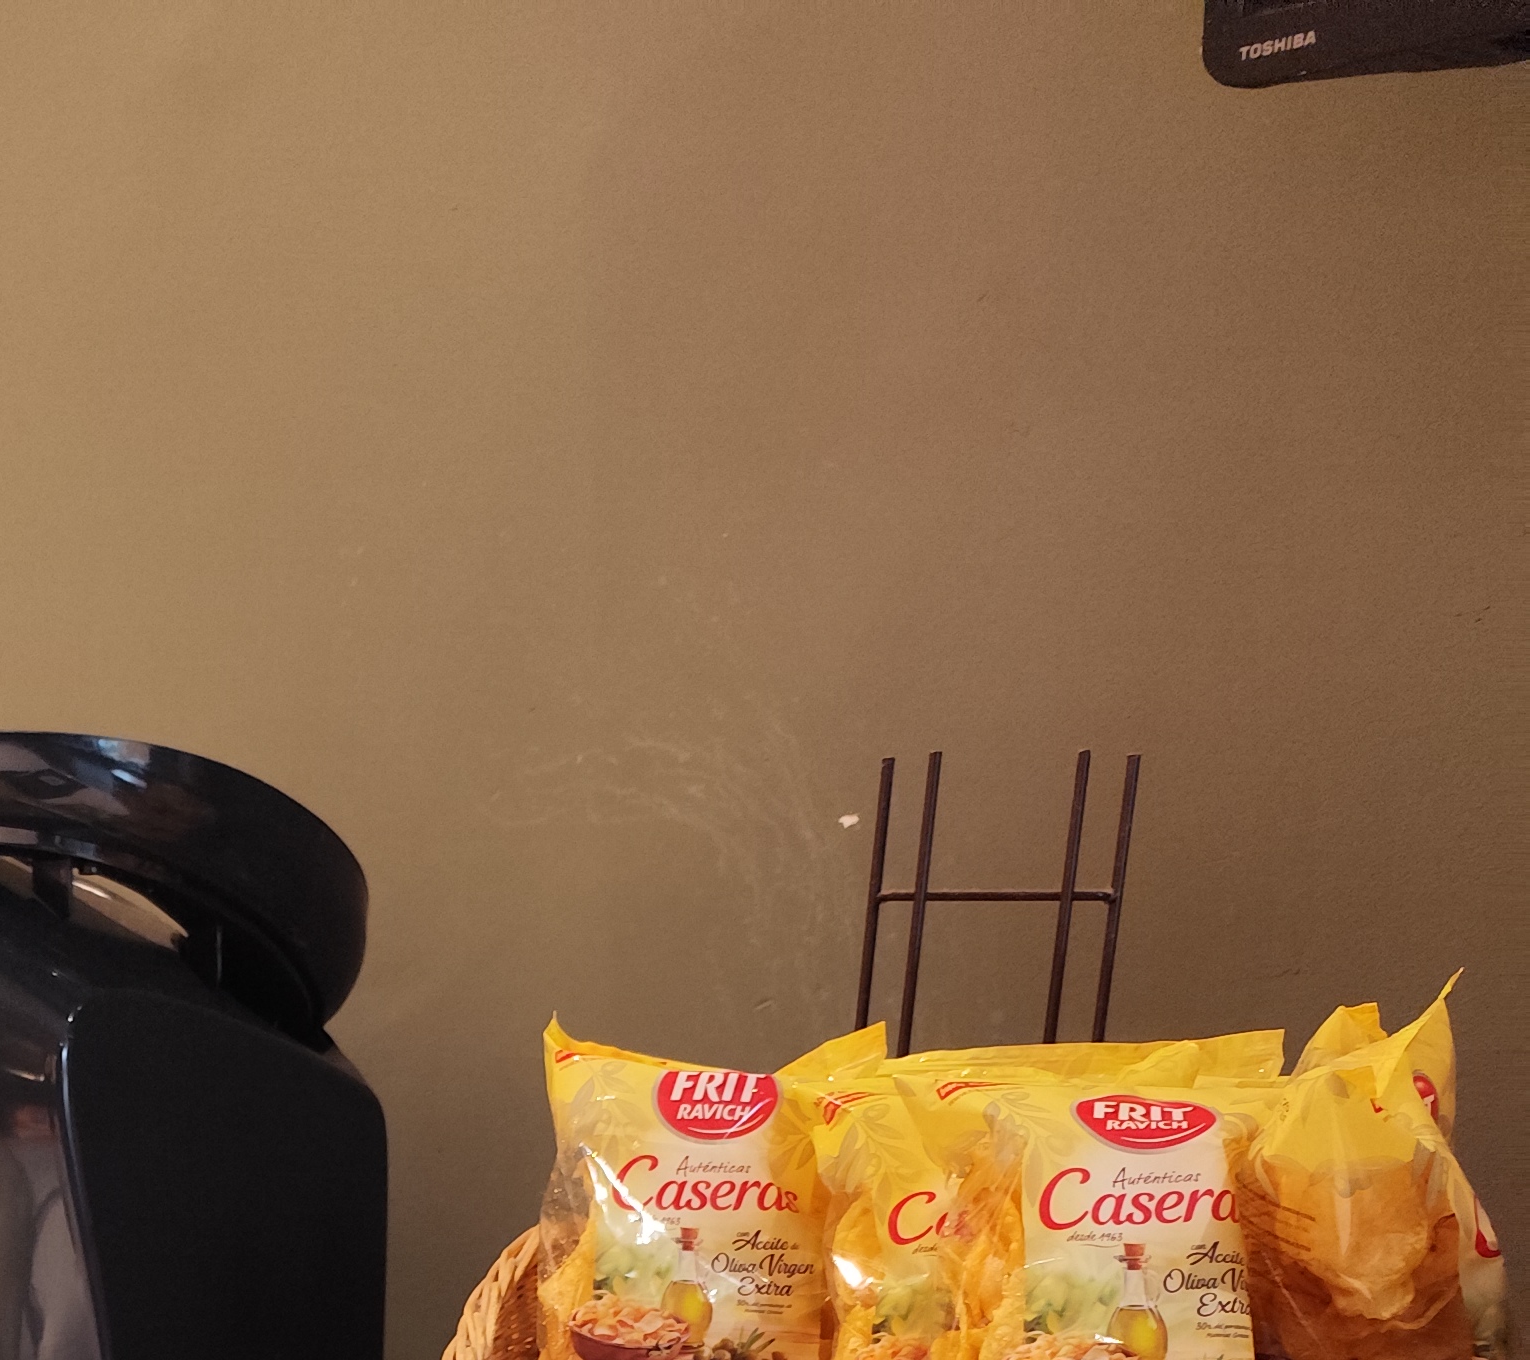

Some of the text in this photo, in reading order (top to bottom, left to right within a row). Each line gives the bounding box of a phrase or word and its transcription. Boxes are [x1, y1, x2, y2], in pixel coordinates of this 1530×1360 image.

[1239, 30, 1317, 61] TOSHIBA
[676, 1103, 752, 1121] RAVICH
[1093, 1101, 1194, 1122] FRIT
[1106, 1120, 1189, 1131] RAVICH
[675, 1155, 751, 1176] Auténticas
[611, 1154, 800, 1214] Caseras
[1112, 1167, 1202, 1190] Auténticas
[711, 1252, 815, 1277] Oliva Virgen
[737, 1276, 795, 1298] Extra
[1163, 1268, 1219, 1293] Oliva
